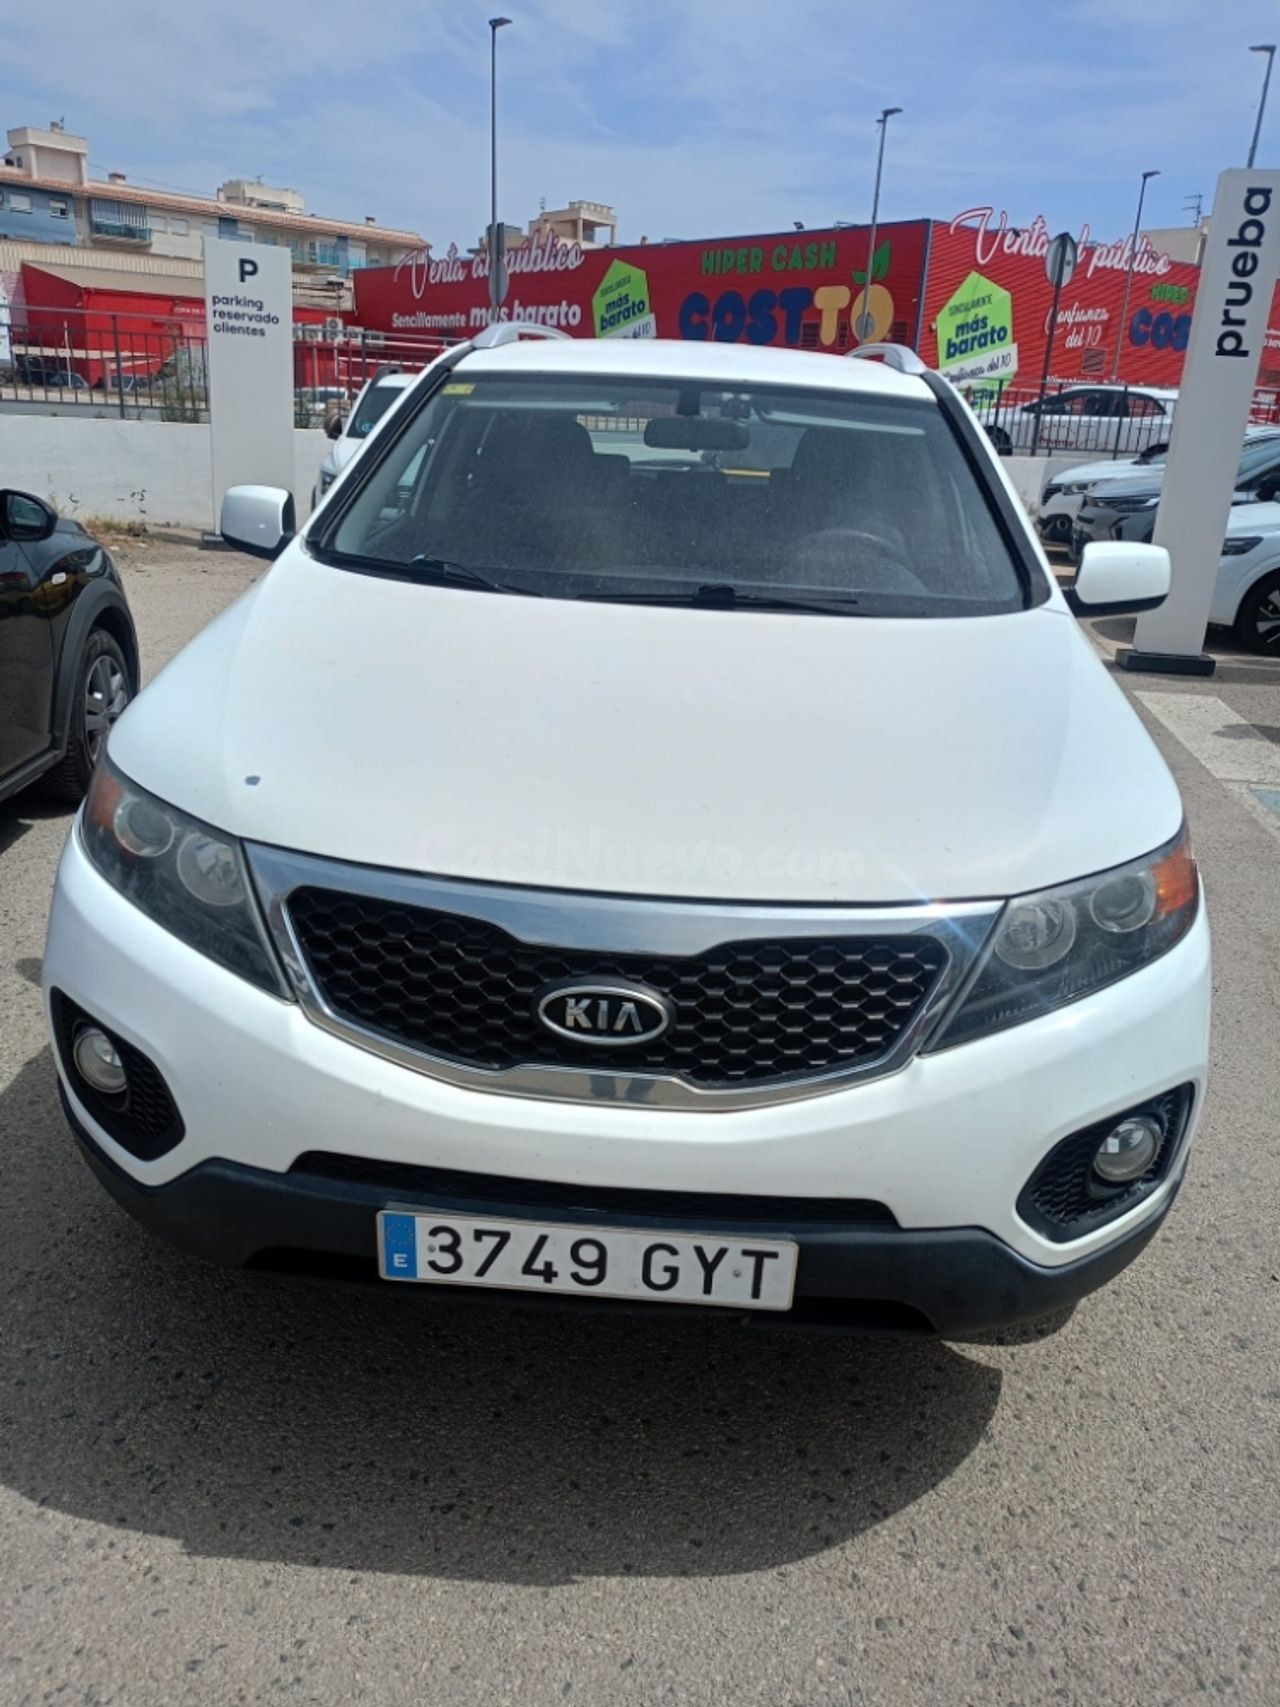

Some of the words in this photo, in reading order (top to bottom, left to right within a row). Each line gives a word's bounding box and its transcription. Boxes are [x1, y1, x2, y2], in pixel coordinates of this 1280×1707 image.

[239, 258, 259, 283] P
[393, 242, 467, 299] Venta
[702, 249, 763, 275] HIPER
[771, 241, 836, 272] CASH
[1215, 187, 1272, 357] prueba
[212, 295, 264, 312] parking
[213, 309, 280, 325] reservado
[392, 311, 466, 329] Sencillamente
[513, 299, 581, 326] barato
[601, 299, 646, 332] barato
[678, 283, 895, 346] COSTTO
[213, 322, 266, 337] clientes
[955, 314, 989, 338] más
[1065, 328, 1084, 348] del
[1085, 325, 1102, 346] 10
[946, 326, 1008, 360] barato
[564, 998, 642, 1033] KIA
[393, 1253, 408, 1268] E
[427, 1225, 608, 1287] 3749
[641, 1243, 779, 1300] GYT
